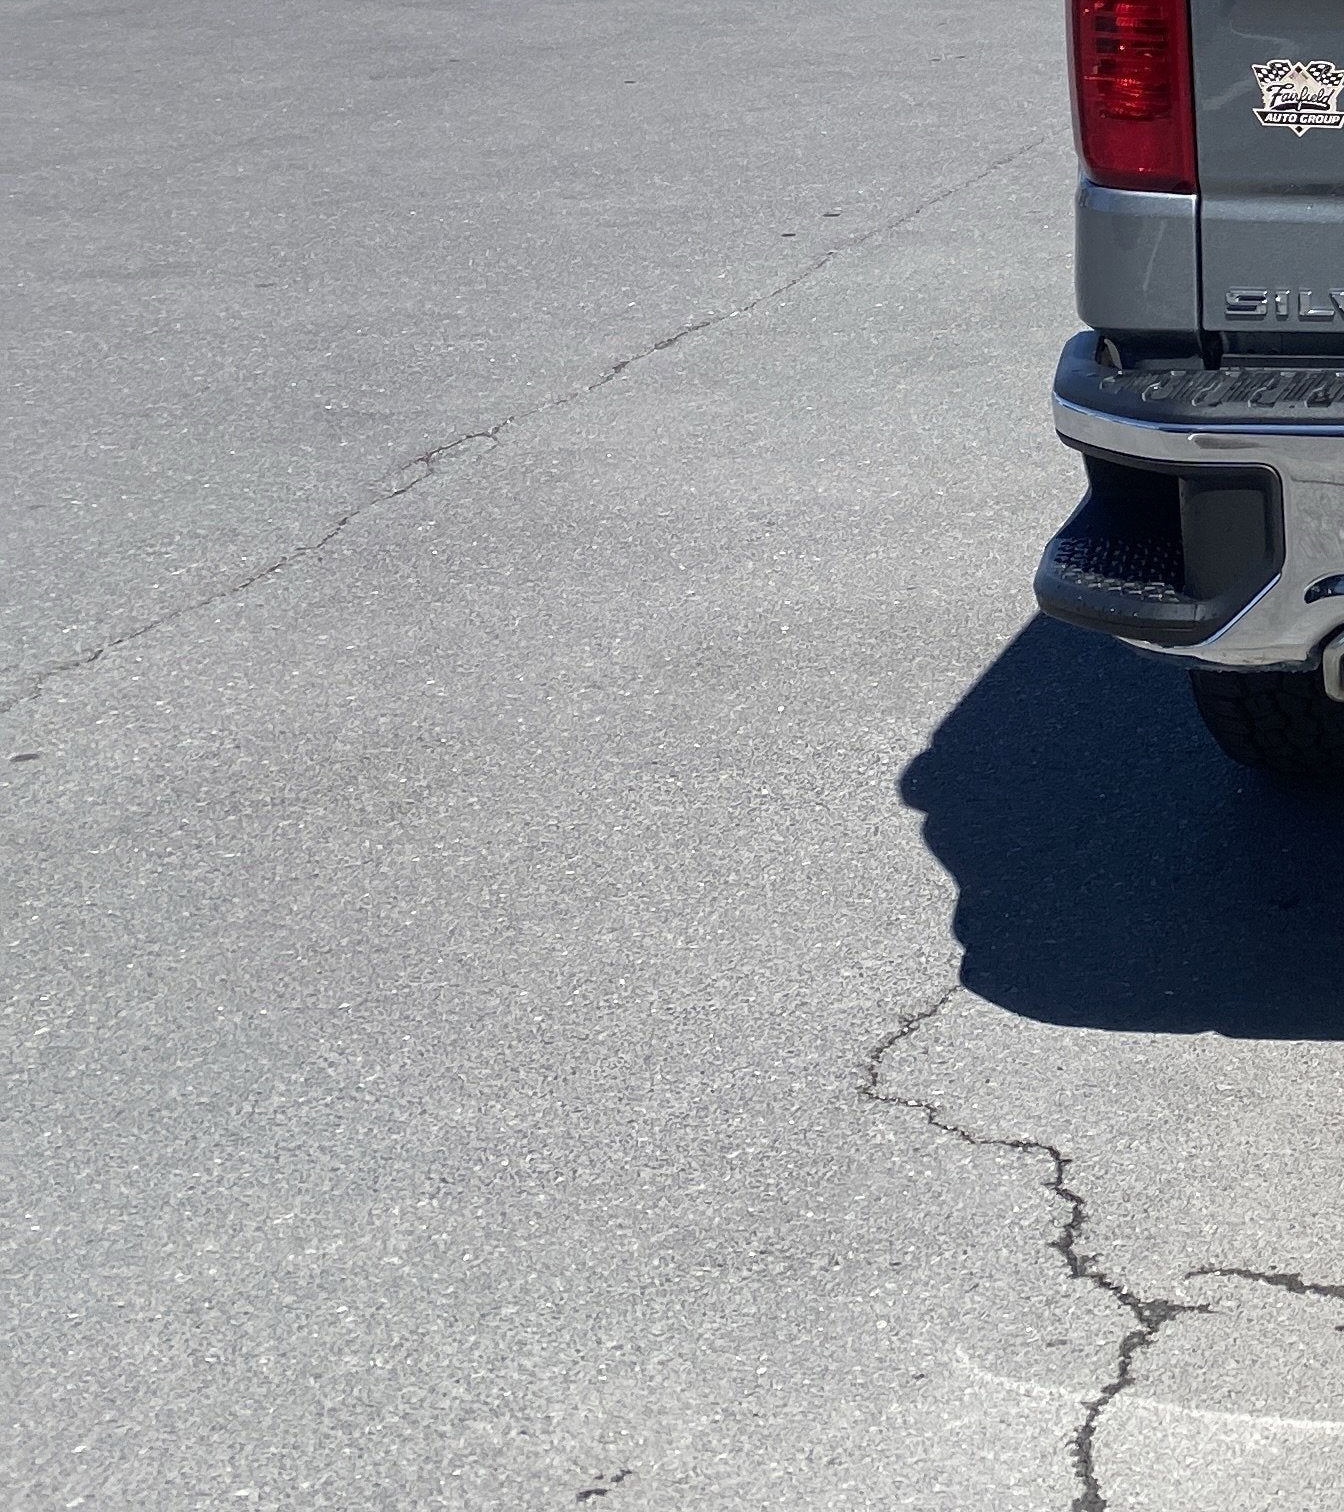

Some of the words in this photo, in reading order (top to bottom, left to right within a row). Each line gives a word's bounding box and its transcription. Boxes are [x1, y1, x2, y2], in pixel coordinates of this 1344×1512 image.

[1266, 83, 1336, 109] Fairfield
[1264, 113, 1298, 123] AUTO
[1299, 114, 1341, 124] GROUP
